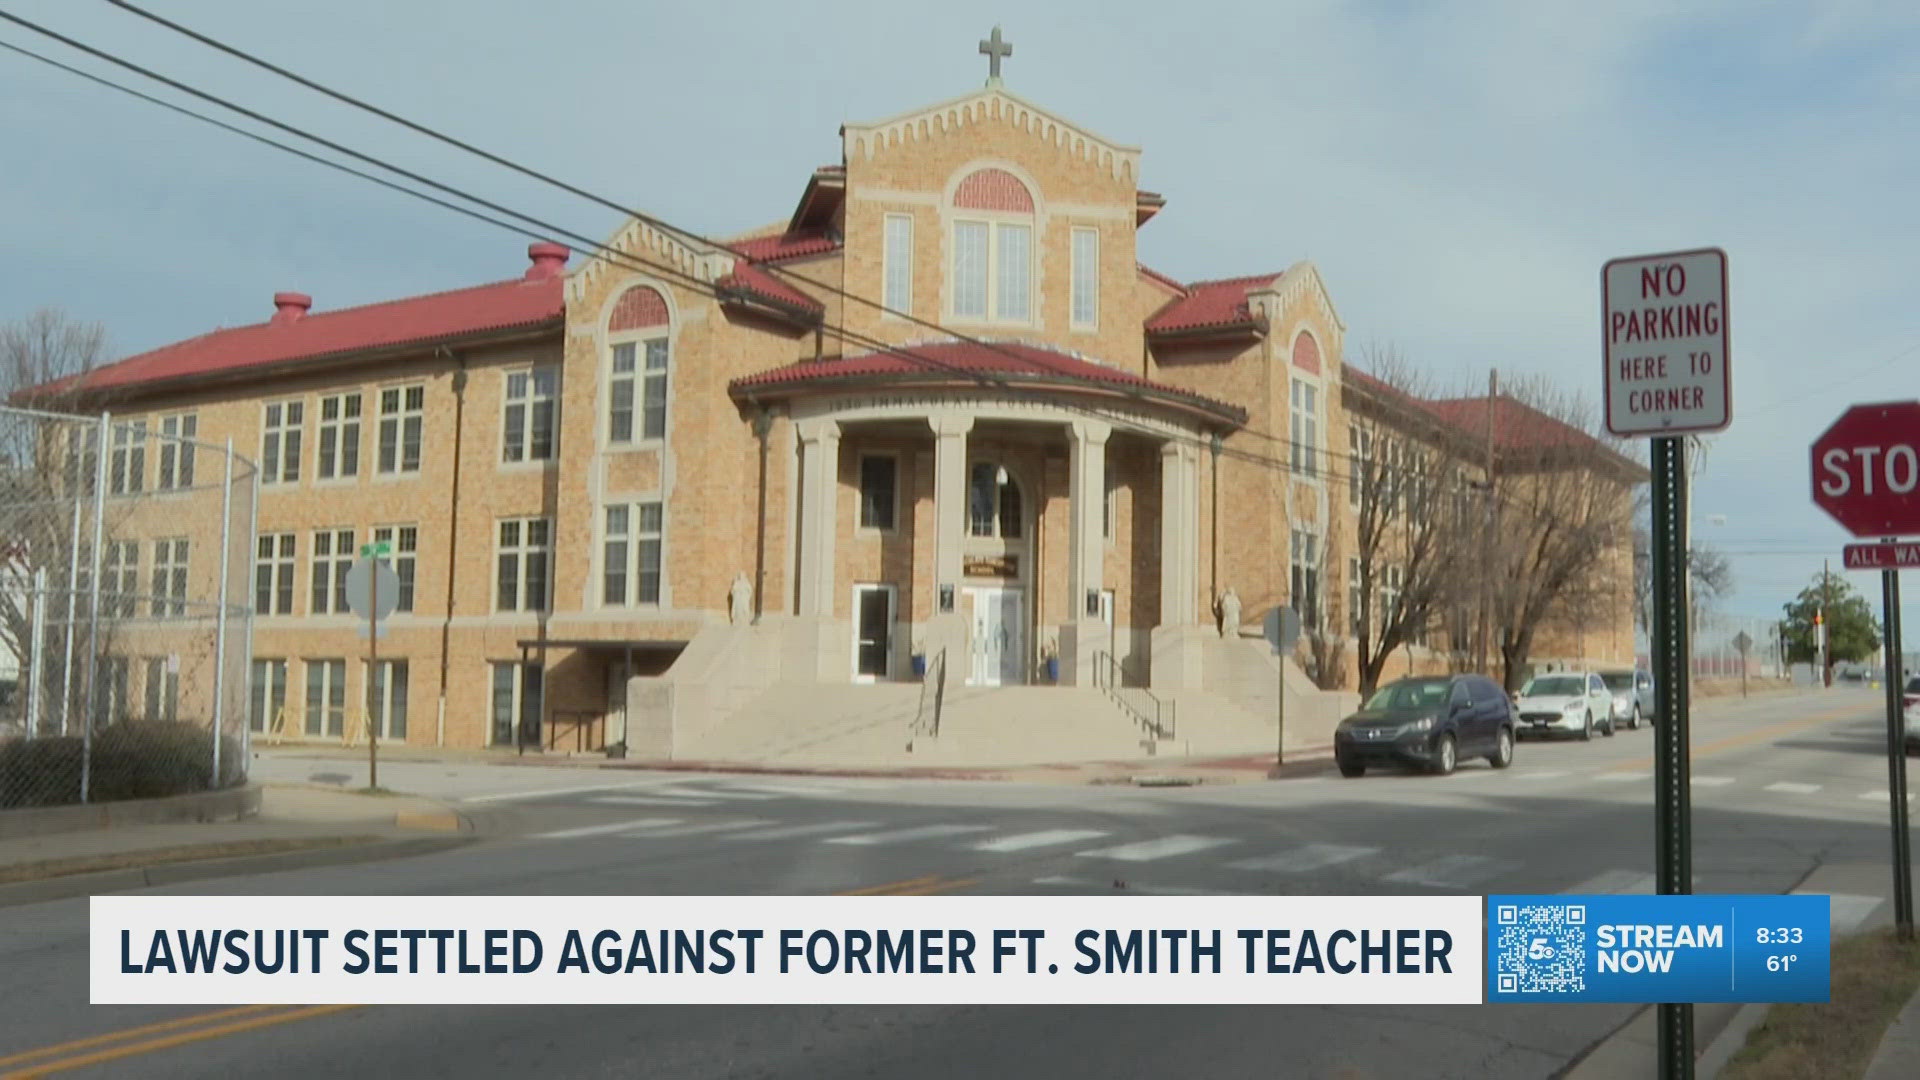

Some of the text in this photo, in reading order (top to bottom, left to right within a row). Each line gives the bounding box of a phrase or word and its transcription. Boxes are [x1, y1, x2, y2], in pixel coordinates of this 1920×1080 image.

[1641, 263, 1686, 300] NO
[1612, 301, 1719, 344] PARKING
[1620, 351, 1712, 382] HERE TO
[1629, 385, 1704, 414] CORNER
[1821, 444, 1919, 497] STO
[1850, 545, 1920, 566] ALL WA
